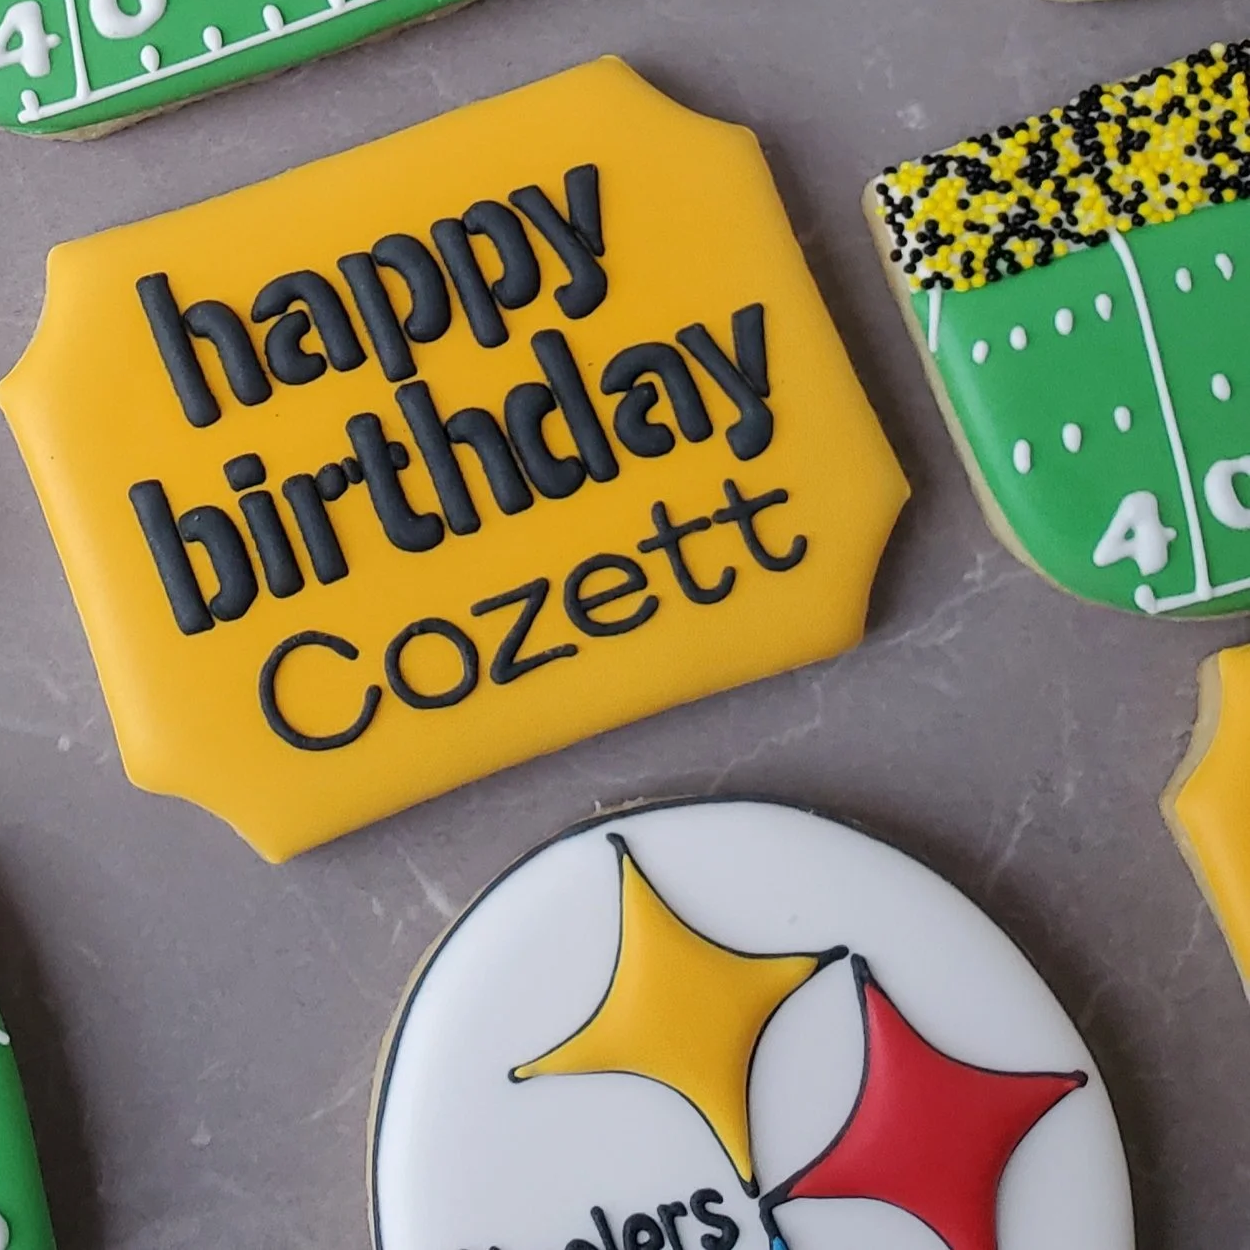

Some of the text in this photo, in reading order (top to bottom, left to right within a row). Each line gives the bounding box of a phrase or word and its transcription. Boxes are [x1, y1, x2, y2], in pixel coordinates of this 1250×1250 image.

[135, 163, 609, 427] happy
[128, 302, 774, 635] birthday
[258, 478, 808, 752] Cozett
